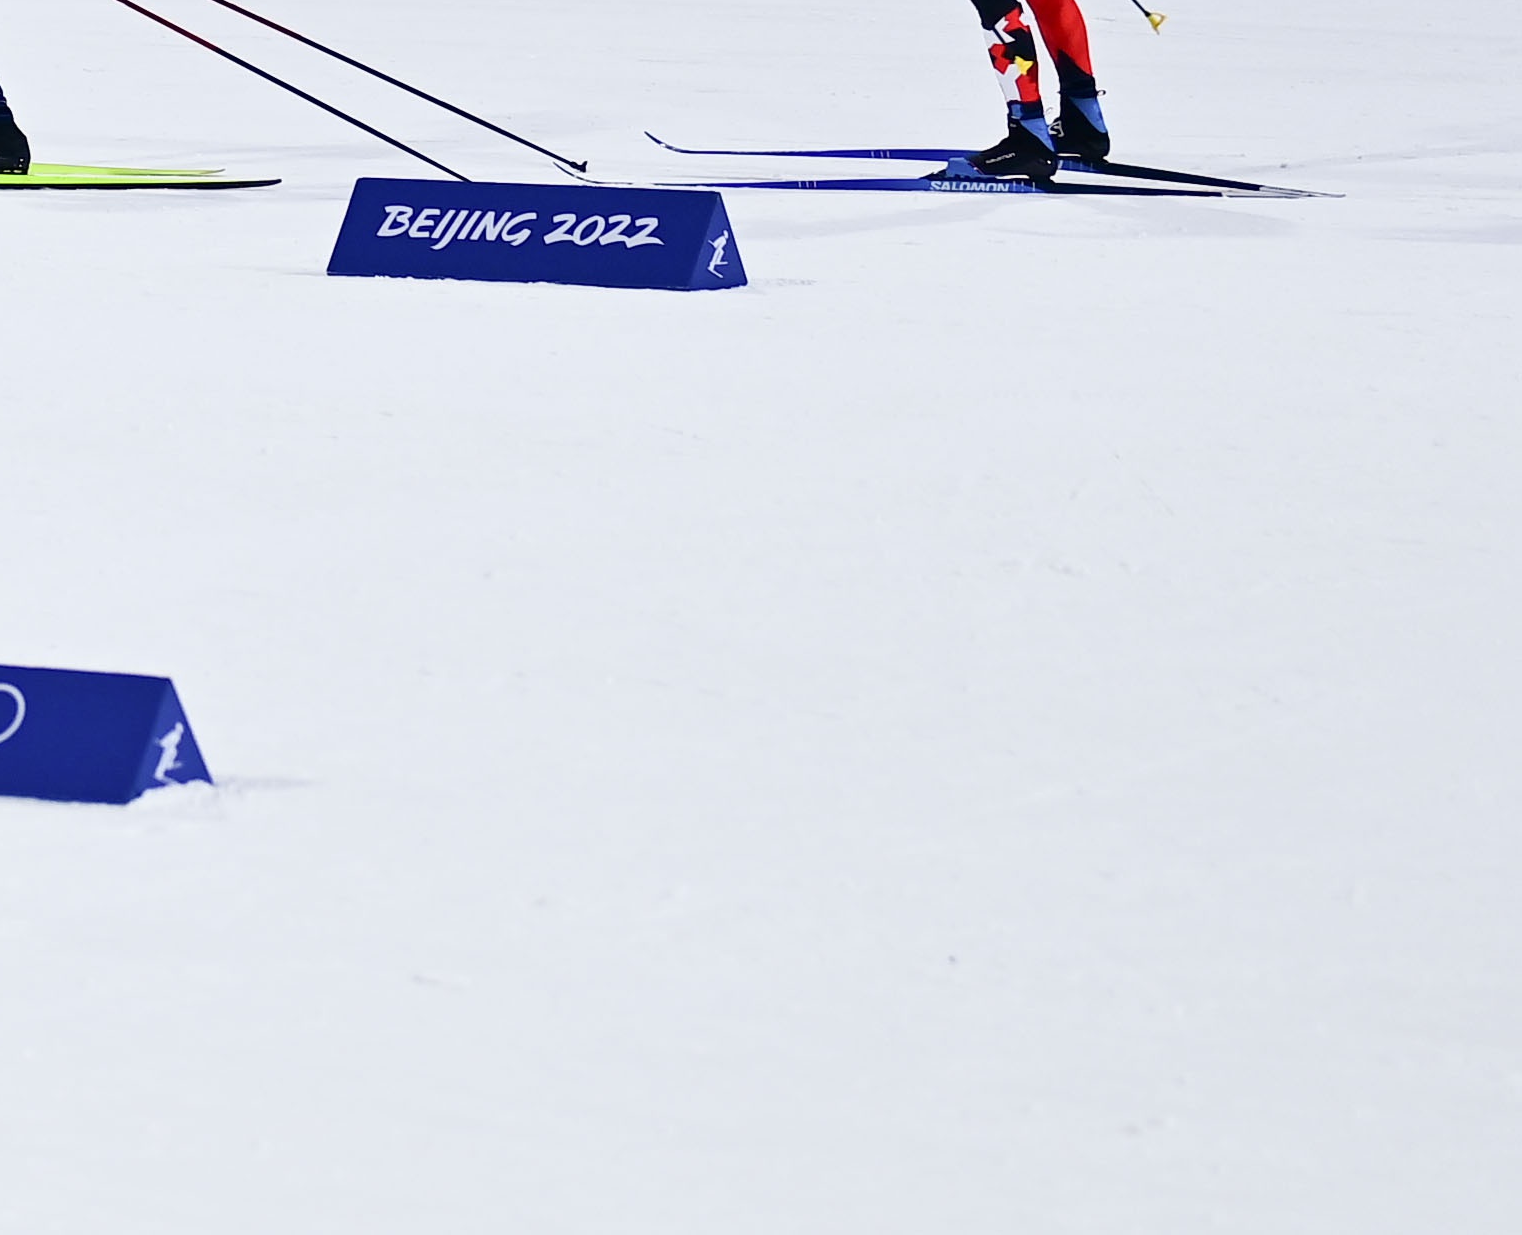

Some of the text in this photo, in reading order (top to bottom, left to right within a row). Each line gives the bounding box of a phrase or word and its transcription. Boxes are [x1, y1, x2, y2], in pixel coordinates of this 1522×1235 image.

[930, 180, 1010, 192] SALOMON
[376, 205, 665, 252] BEIJING 2022
